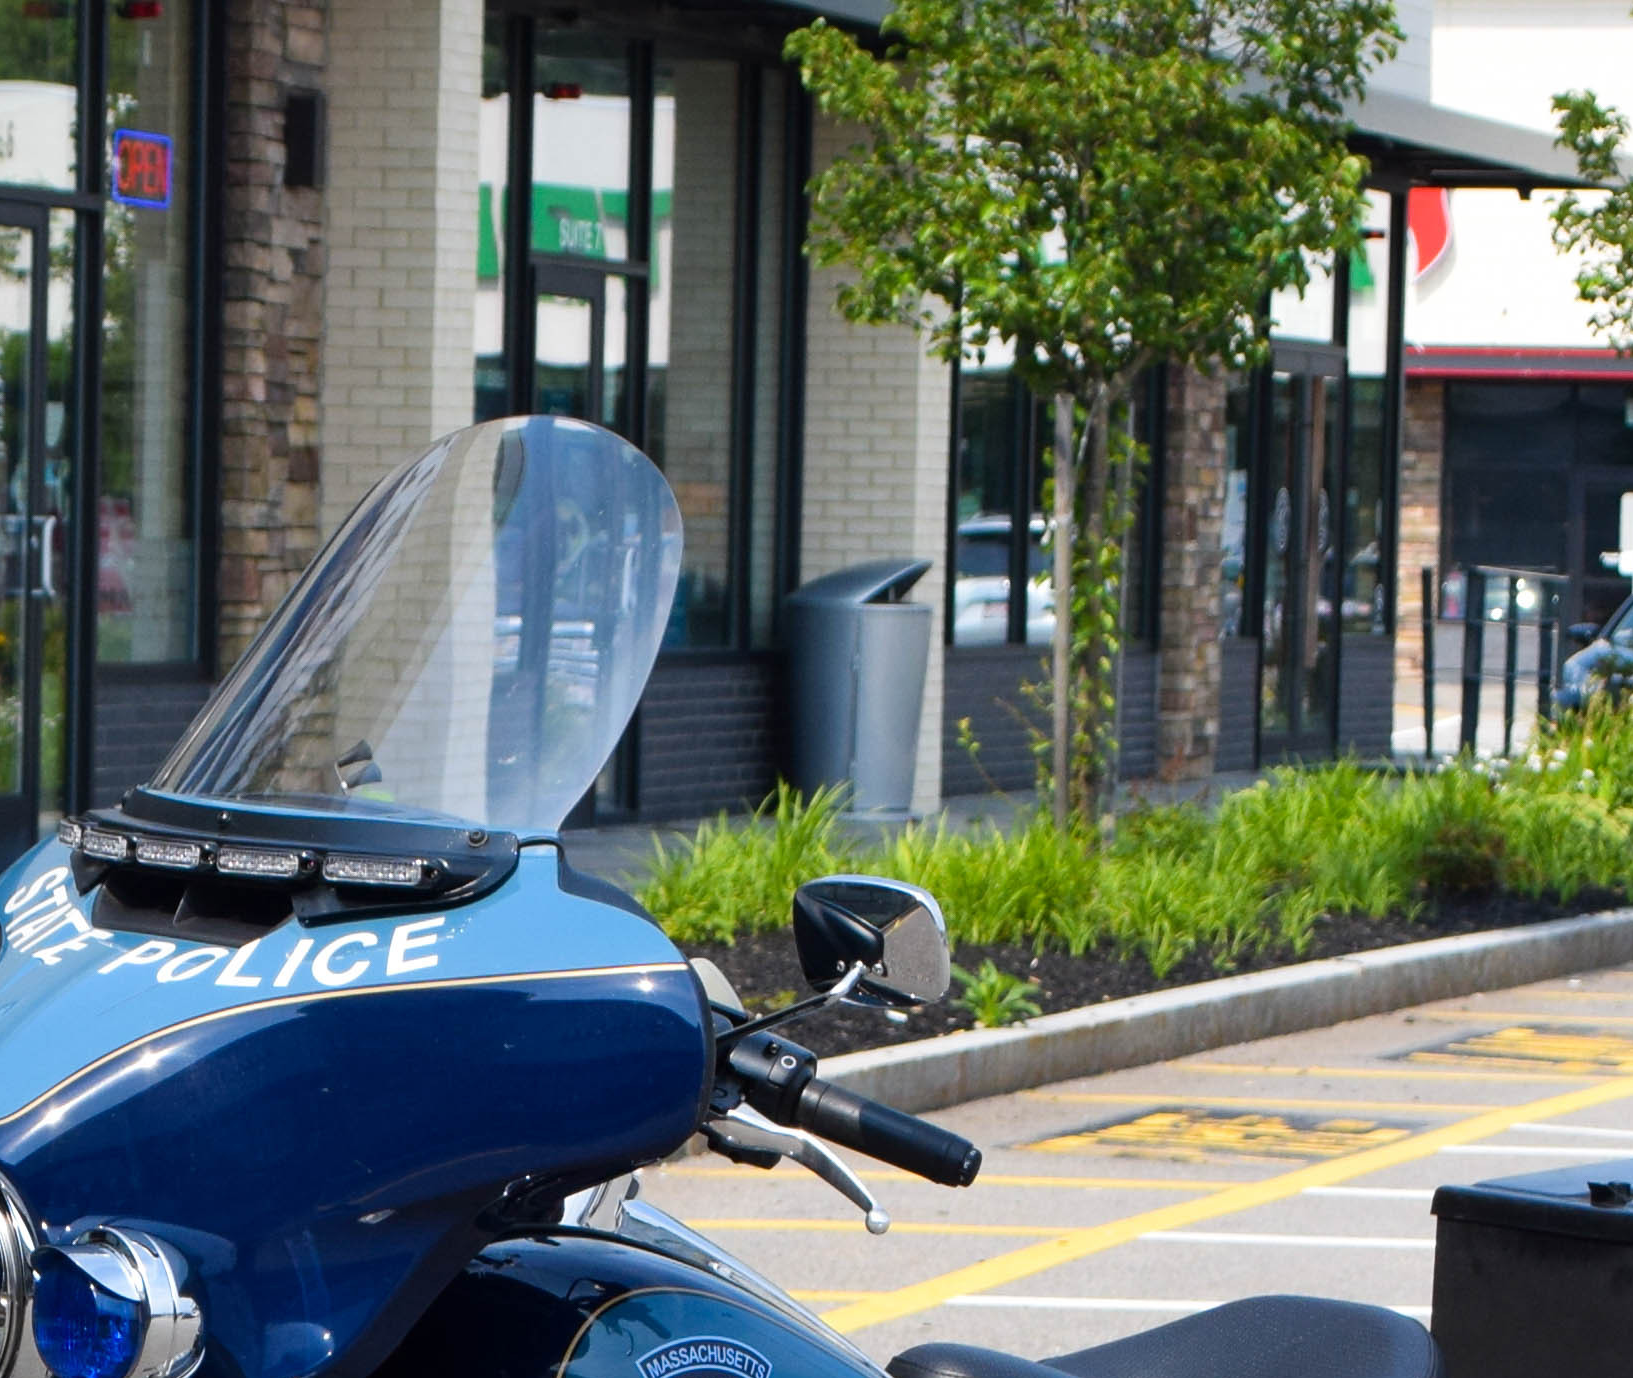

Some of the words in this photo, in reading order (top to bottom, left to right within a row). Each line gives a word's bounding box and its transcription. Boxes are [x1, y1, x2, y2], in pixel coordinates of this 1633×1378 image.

[118, 138, 170, 195] OPEN
[558, 218, 593, 249] SUITE
[4, 866, 116, 966] STATE
[97, 916, 447, 988] POLICE
